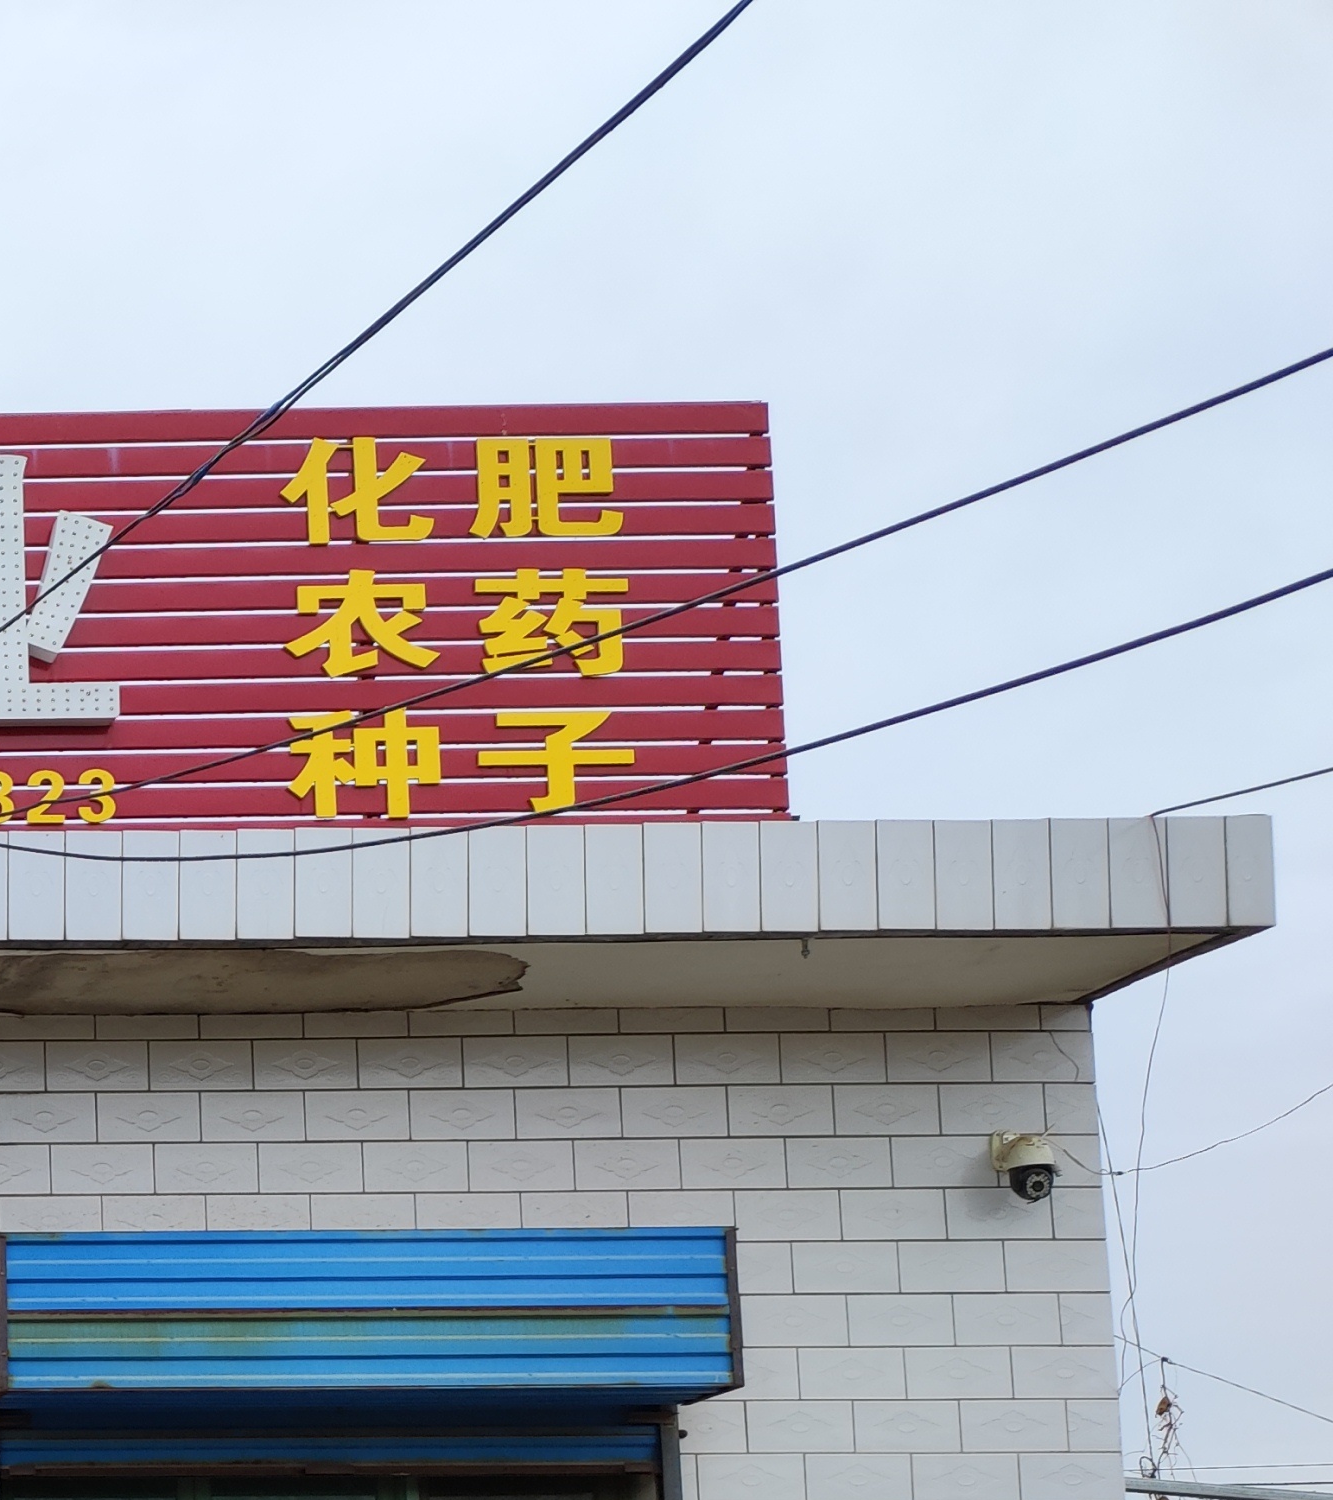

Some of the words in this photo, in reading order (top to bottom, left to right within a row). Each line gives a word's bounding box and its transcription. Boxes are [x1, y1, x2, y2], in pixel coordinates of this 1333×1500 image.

[279, 436, 624, 546] 化肥
[283, 567, 629, 678] 农药
[287, 706, 635, 820] 种子
